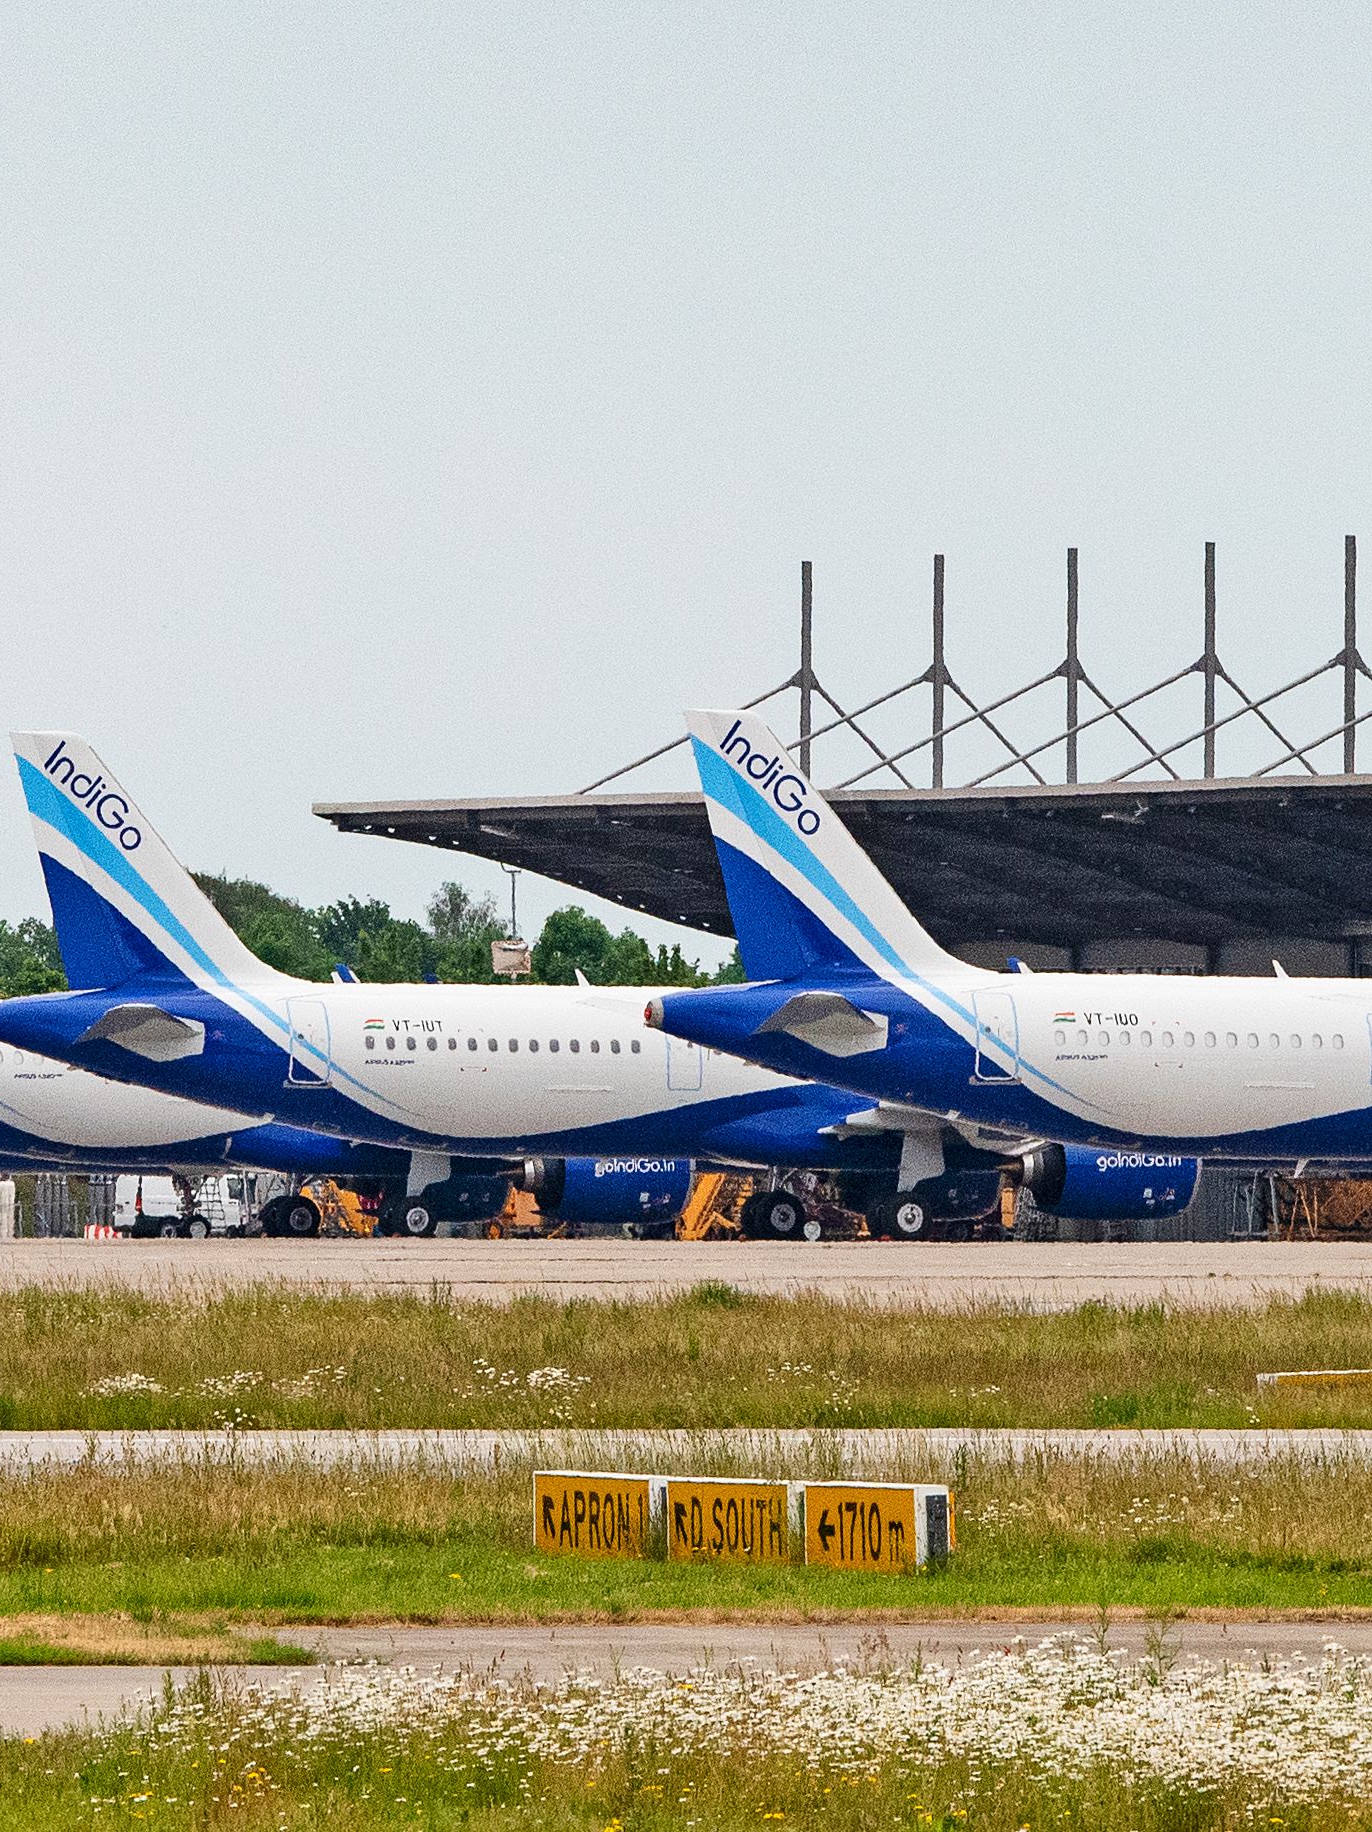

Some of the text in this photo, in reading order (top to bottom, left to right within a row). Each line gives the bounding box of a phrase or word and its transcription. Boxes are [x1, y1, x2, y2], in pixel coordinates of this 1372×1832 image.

[44, 740, 141, 850] IndiGo
[720, 719, 820, 835] IndiGo
[393, 1019, 443, 1032] VT-IUT
[559, 1490, 630, 1551] APRON
[691, 1496, 782, 1556] D SOUTH
[838, 1502, 905, 1562] 1710 m
